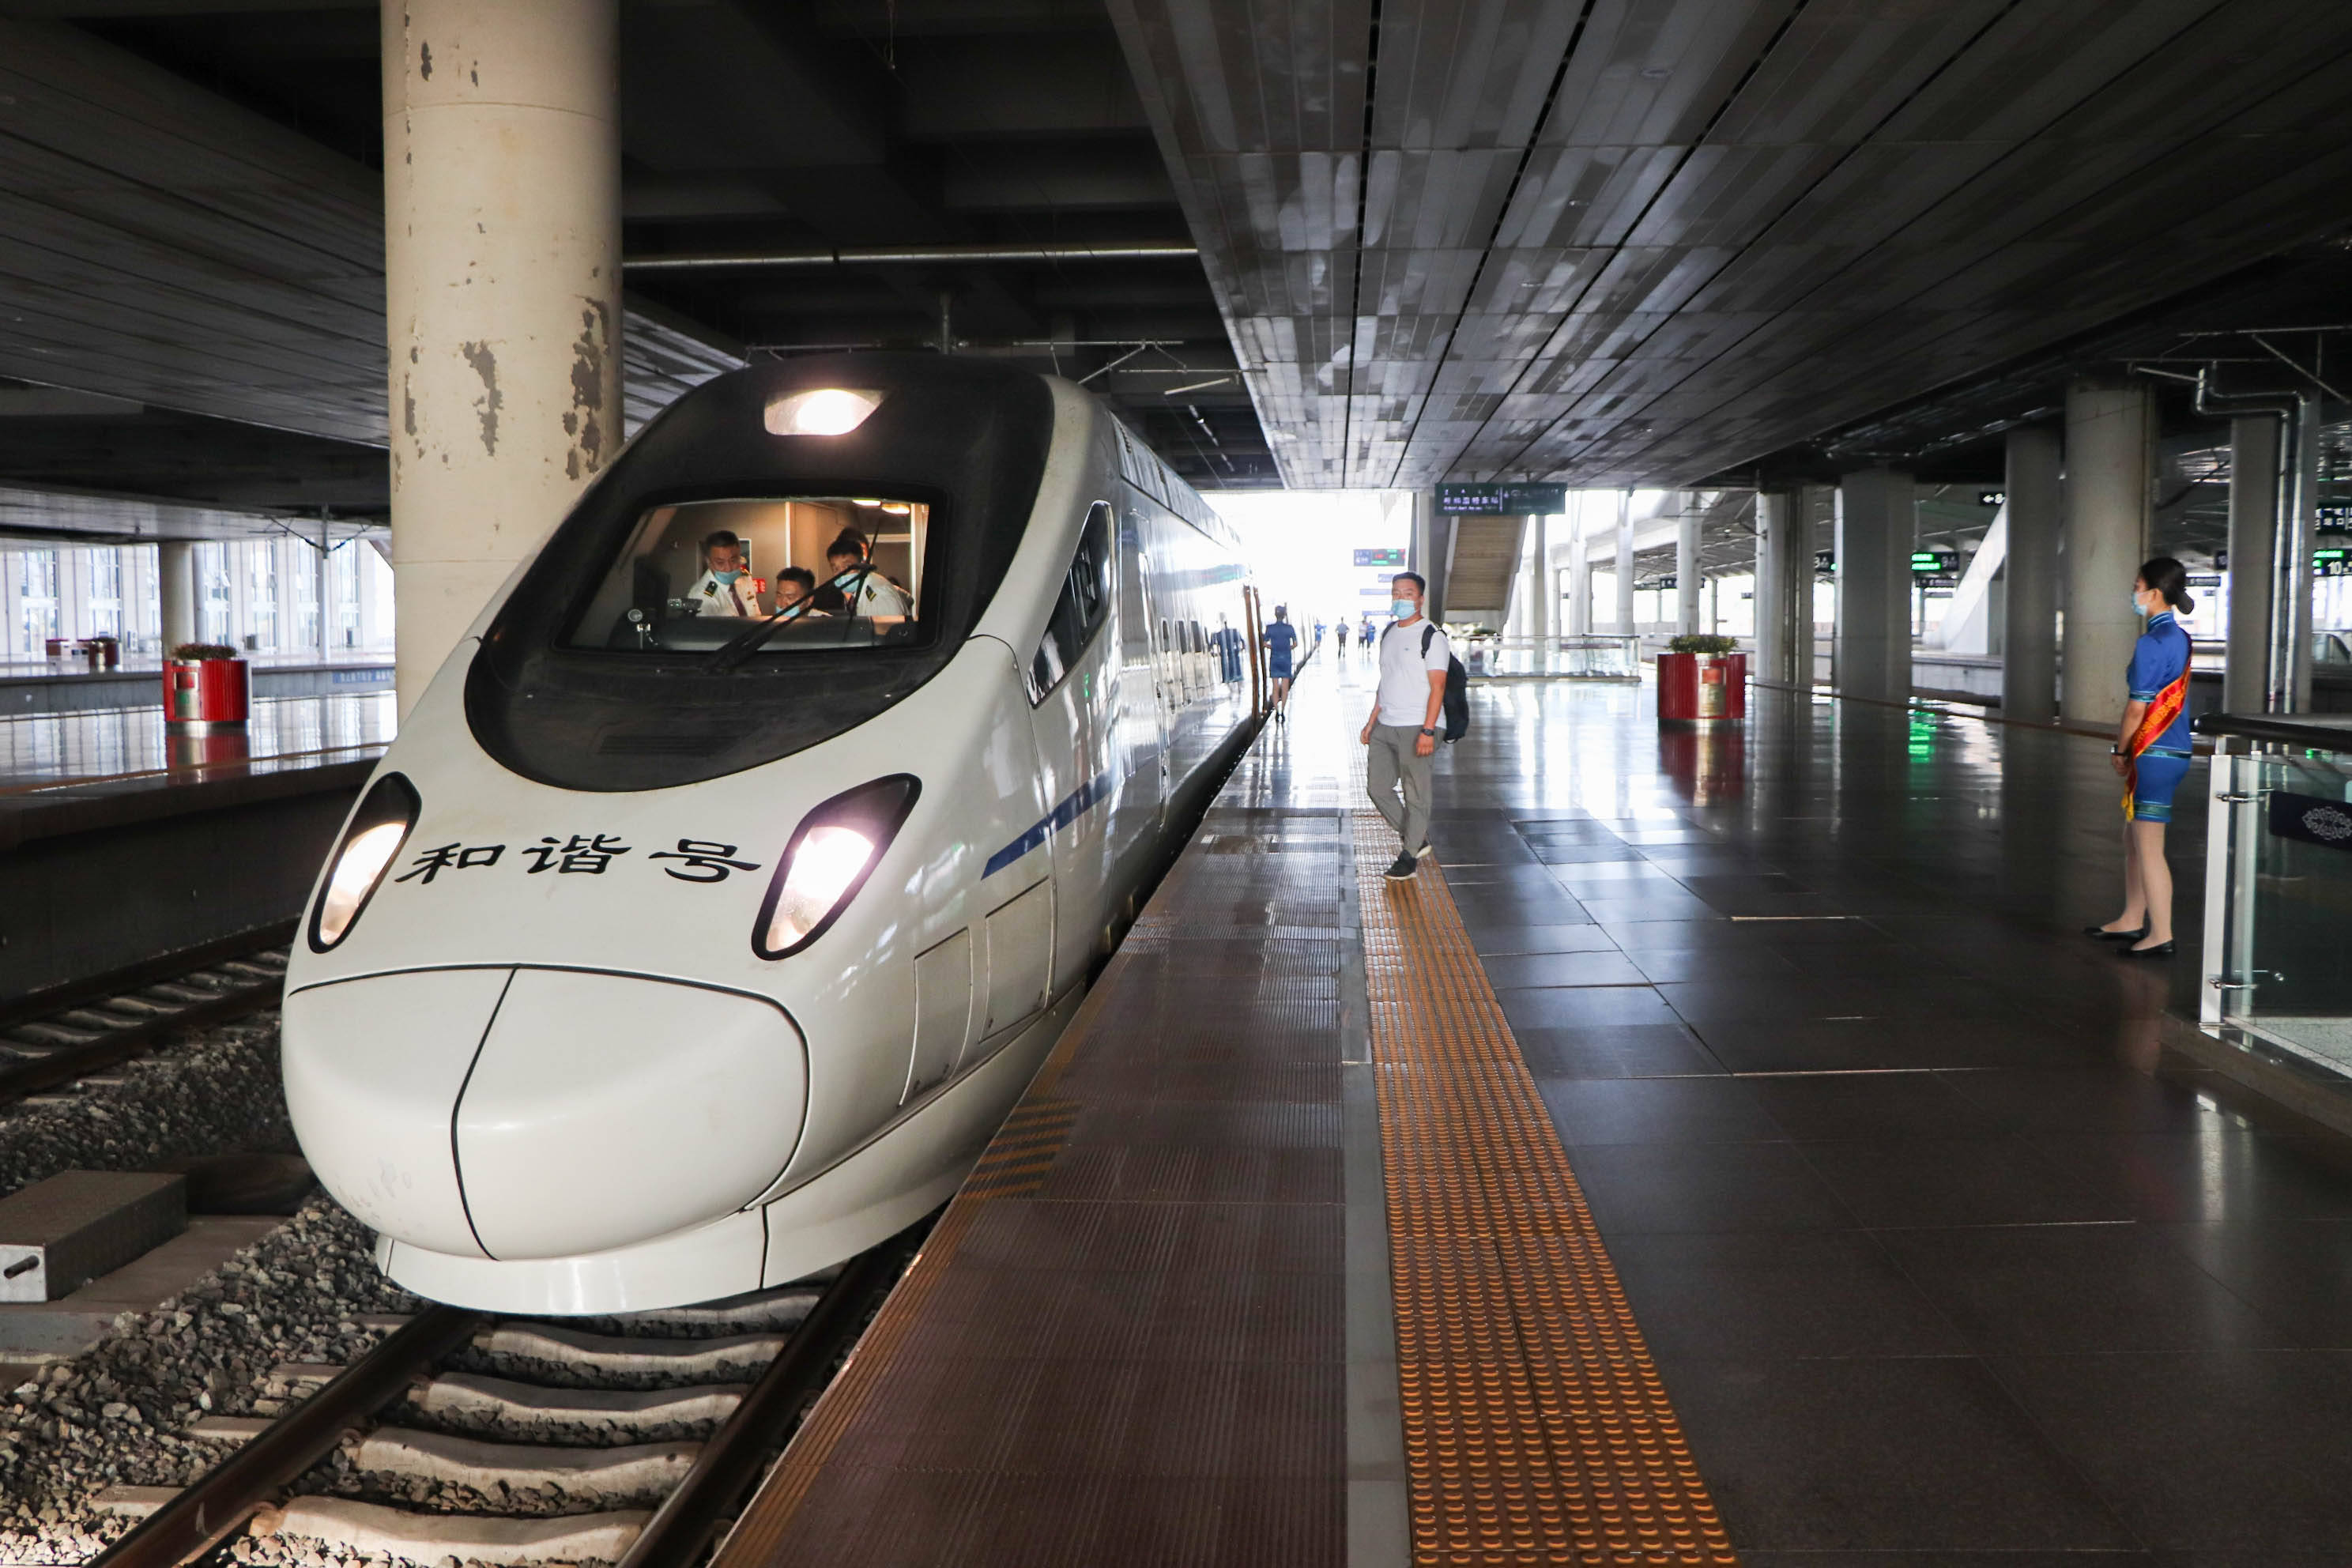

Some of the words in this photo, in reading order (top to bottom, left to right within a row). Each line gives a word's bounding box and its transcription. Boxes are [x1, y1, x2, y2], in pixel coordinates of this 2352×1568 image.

[2327, 560, 2343, 575] 10
[394, 833, 762, 884] 和谐号
